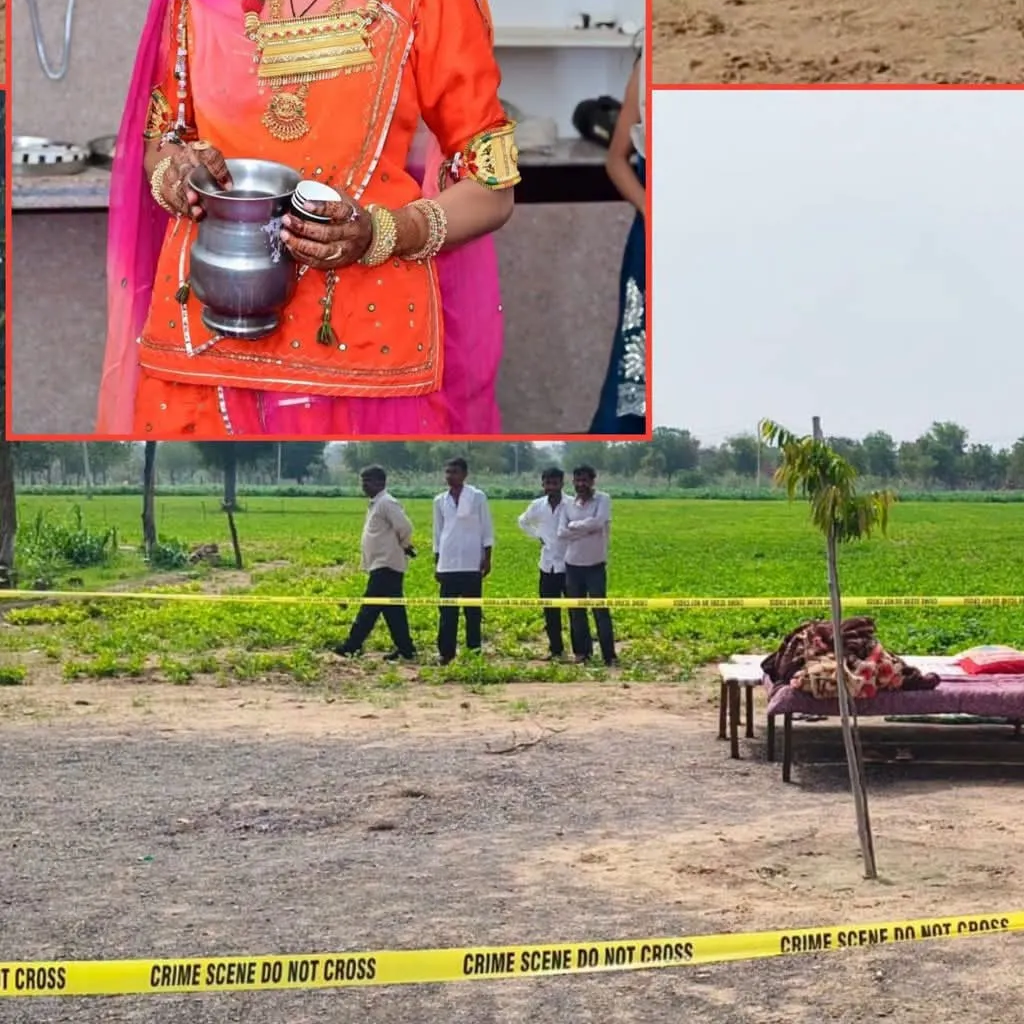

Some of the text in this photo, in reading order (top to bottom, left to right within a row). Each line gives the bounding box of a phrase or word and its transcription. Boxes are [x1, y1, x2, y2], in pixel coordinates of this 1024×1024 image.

[780, 933, 832, 953] CRIME
[837, 928, 889, 948] SCENE
[894, 925, 915, 941] DO
[921, 922, 952, 937] NOT
[150, 958, 376, 987] CRIME SCENE DO NOT CROSS
[463, 943, 693, 975] CRIME SCENE DO NOT CROSS
[15, 967, 66, 990] CROSS
